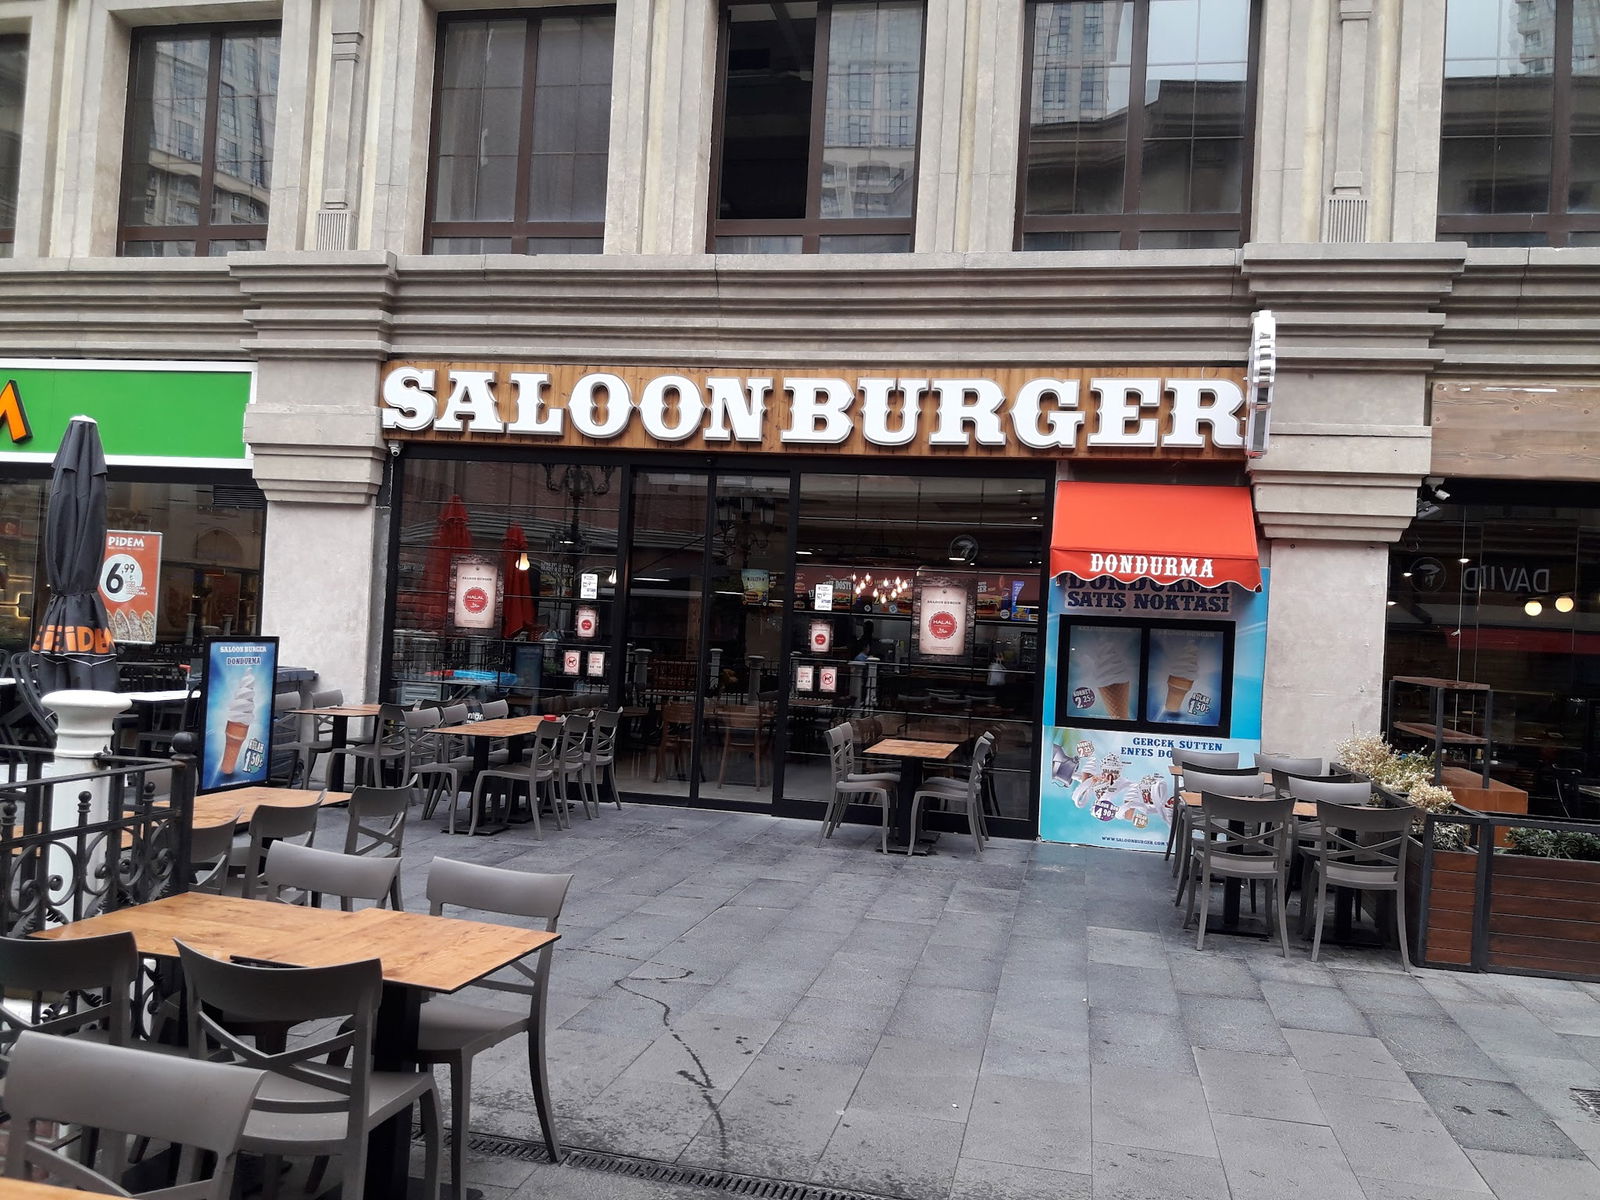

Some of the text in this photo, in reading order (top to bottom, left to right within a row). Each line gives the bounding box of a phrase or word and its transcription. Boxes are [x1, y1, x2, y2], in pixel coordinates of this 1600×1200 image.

[382, 366, 1245, 449] SALOON BURGER
[1089, 553, 1214, 578] DONDURMA
[1133, 594, 1229, 612] NOKTASI
[227, 657, 261, 665] DONDURMA
[1121, 747, 1153, 757] ENFES
